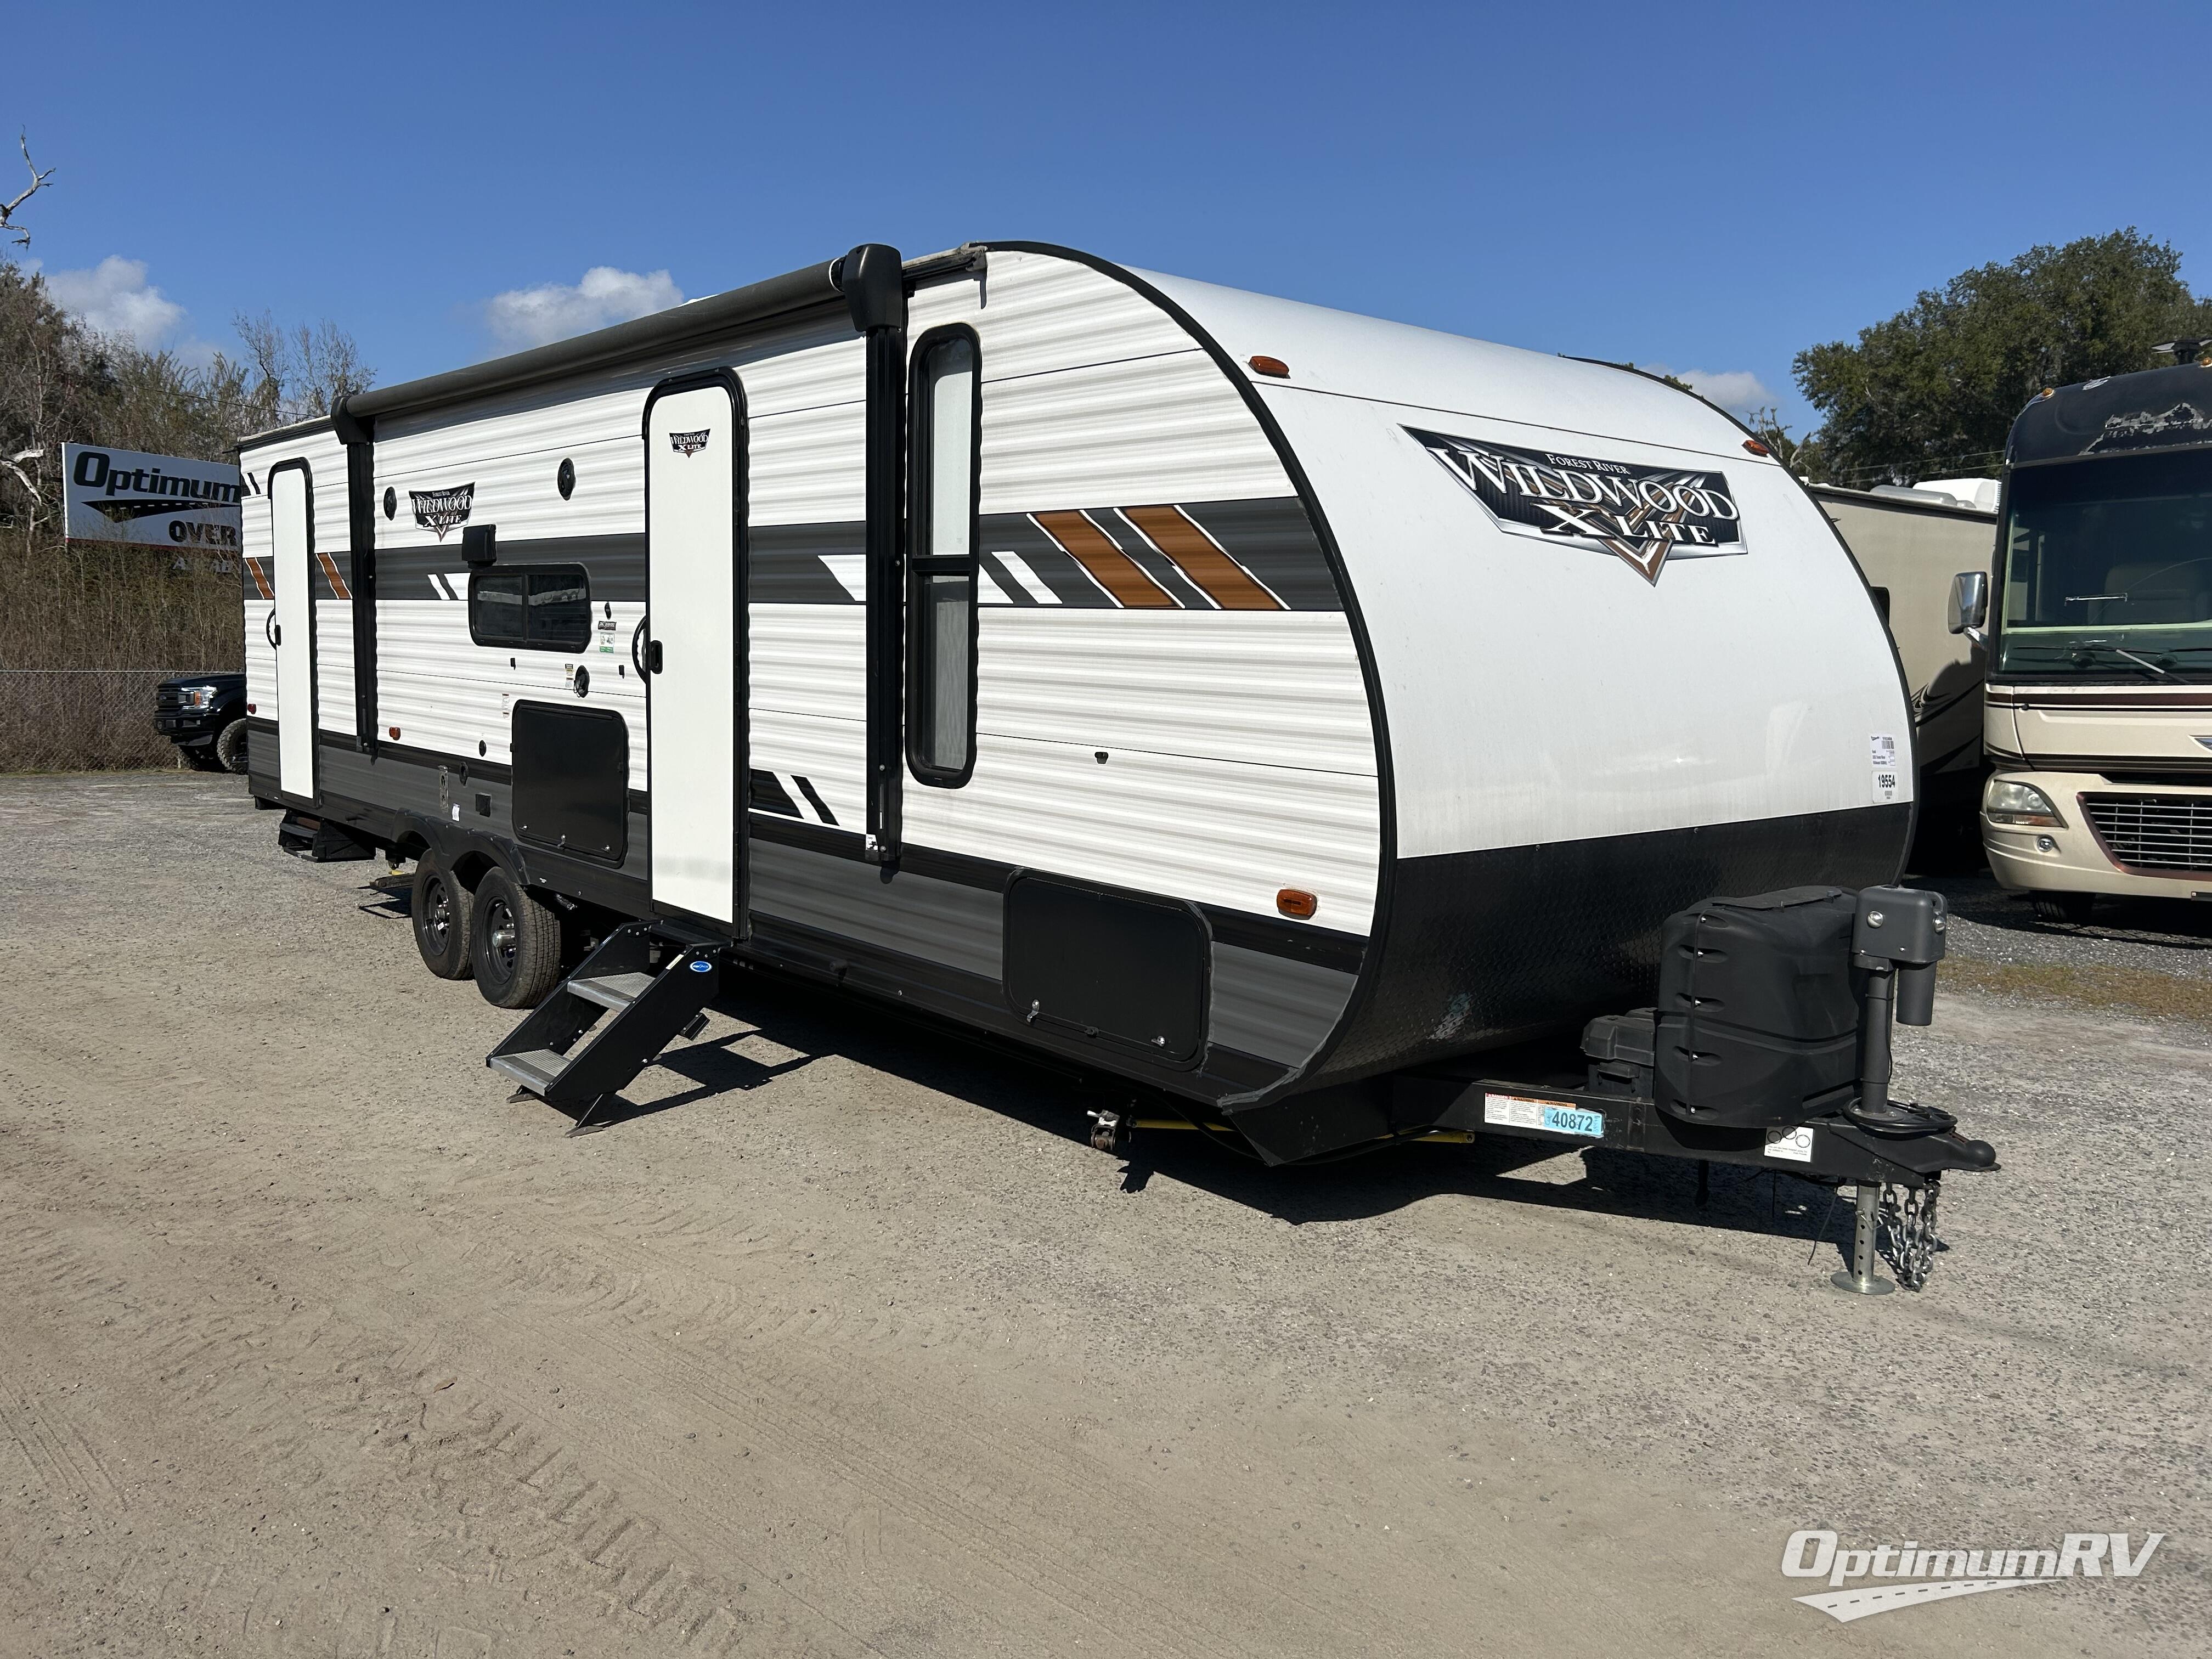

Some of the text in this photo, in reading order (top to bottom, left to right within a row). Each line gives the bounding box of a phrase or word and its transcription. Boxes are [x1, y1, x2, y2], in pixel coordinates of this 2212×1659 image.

[670, 435, 708, 445] WILDWOOD
[1544, 453, 1631, 475] FOREST RIVER
[1426, 447, 1740, 521] WILDWOOD
[411, 495, 472, 514] WILDWOOD
[424, 515, 437, 527] X
[1531, 502, 1719, 547] X LITE
[168, 520, 237, 546] OVER
[1878, 774, 1895, 788] 19554
[1551, 1111, 1593, 1132] 40872
